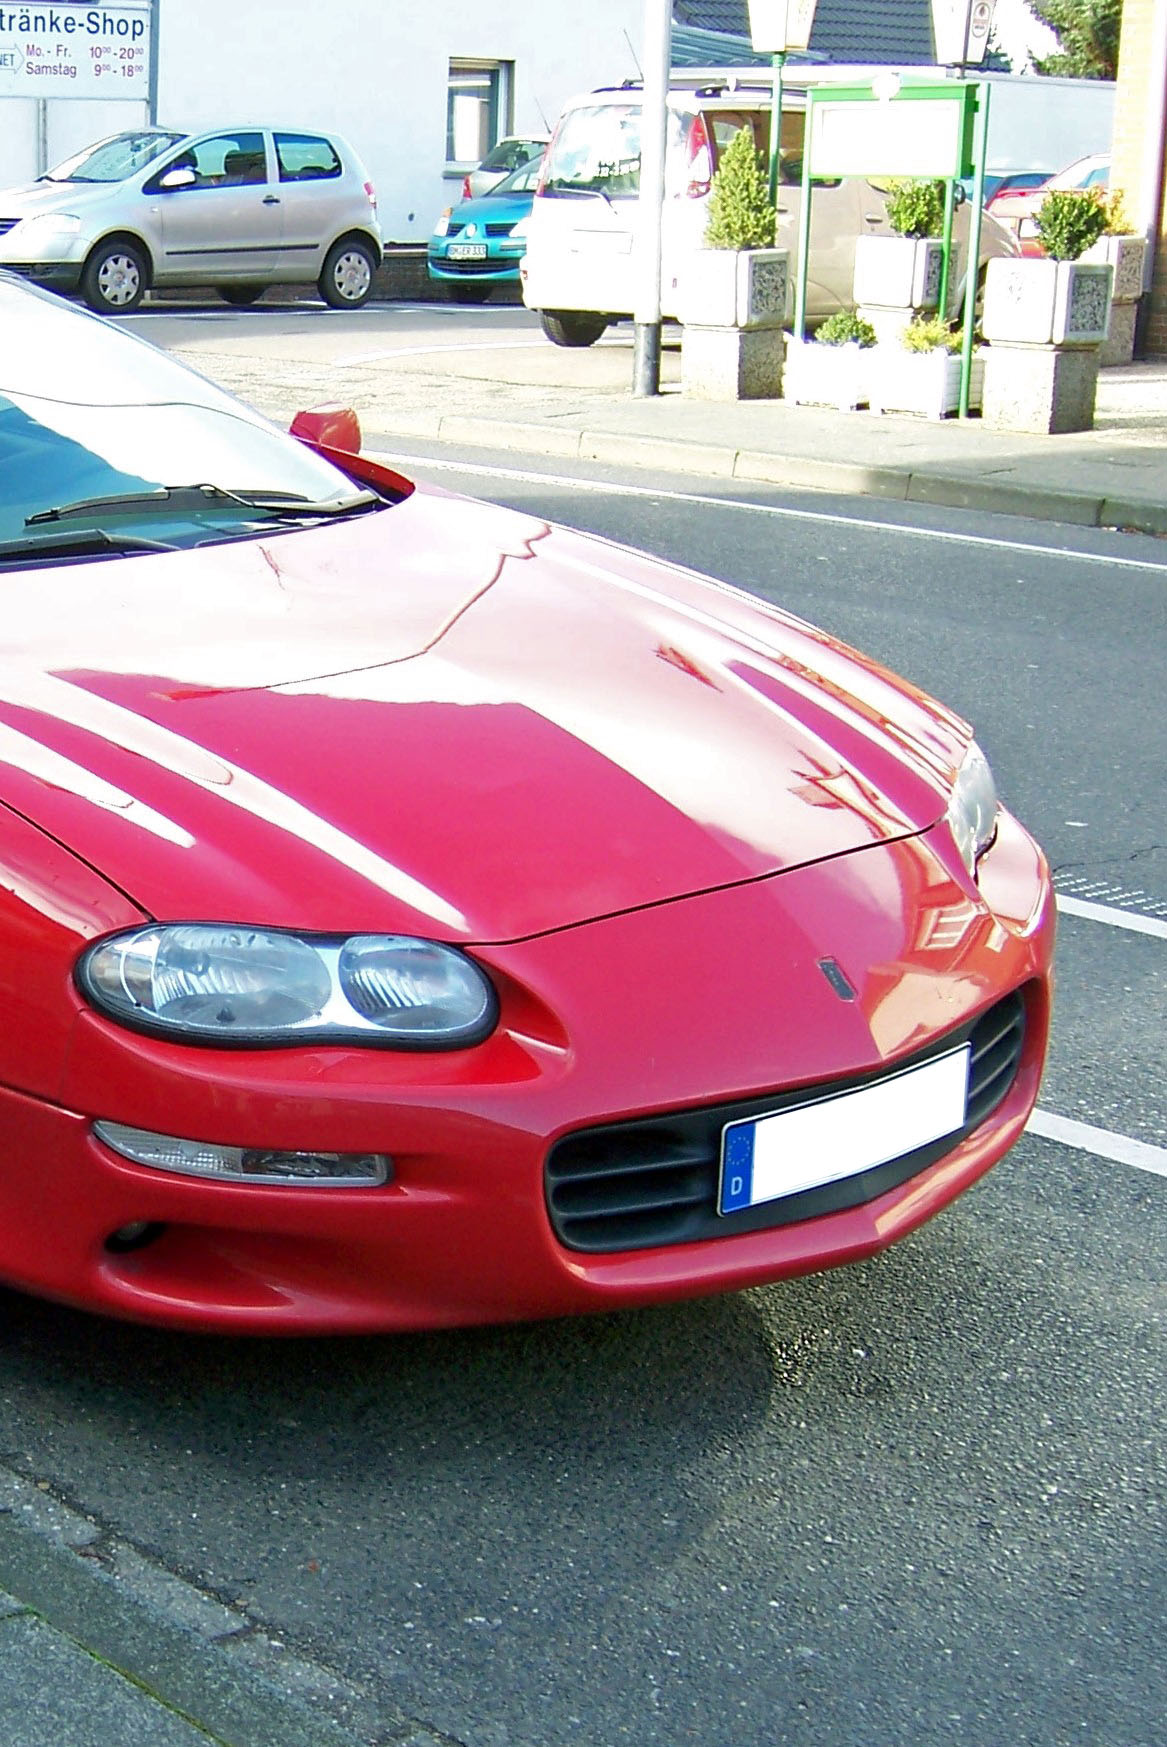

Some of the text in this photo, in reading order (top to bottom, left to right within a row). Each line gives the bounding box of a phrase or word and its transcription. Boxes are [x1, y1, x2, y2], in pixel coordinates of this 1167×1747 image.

[55, 44, 72, 58] Fr.
[26, 61, 77, 78] Samstag
[731, 1176, 743, 1196] D
